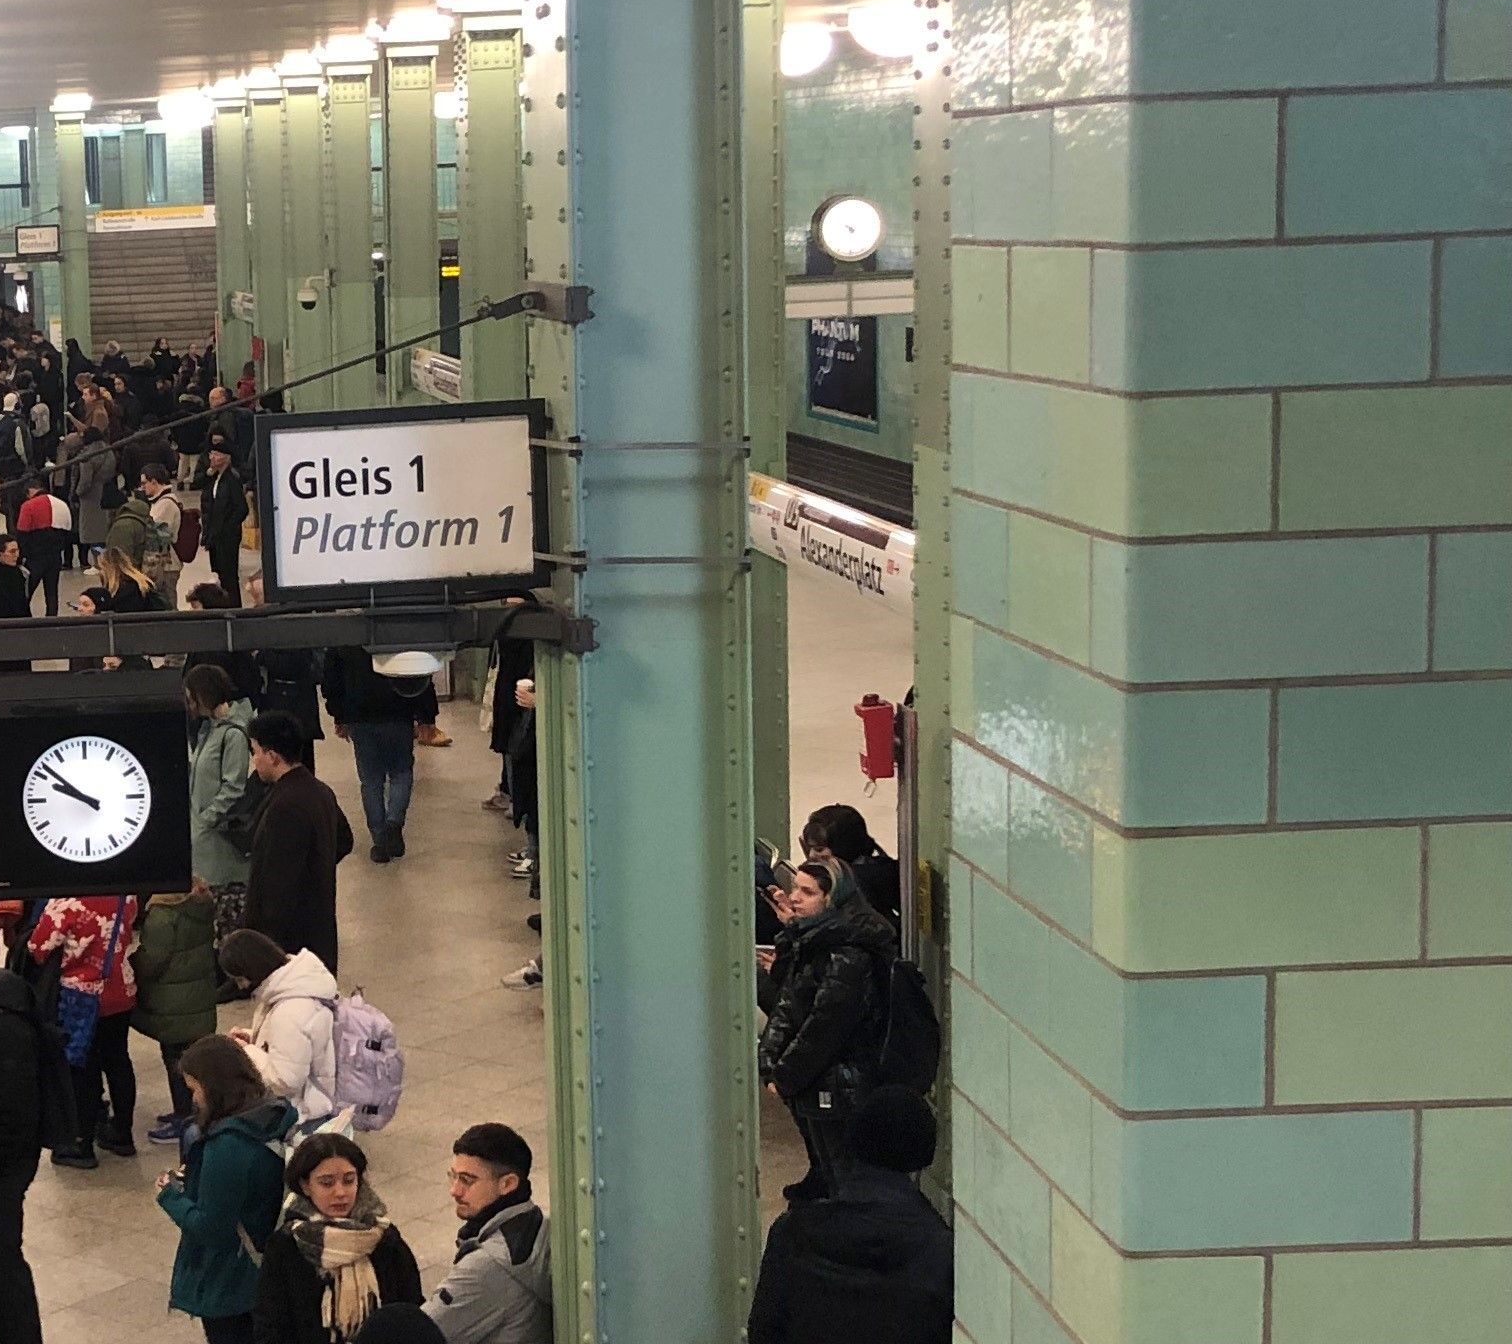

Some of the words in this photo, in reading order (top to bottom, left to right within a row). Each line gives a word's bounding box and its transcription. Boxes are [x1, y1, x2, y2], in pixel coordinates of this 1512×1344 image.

[288, 456, 392, 500] Gleis
[408, 454, 425, 493] 1
[292, 508, 479, 555] Platform
[497, 505, 515, 544] 1
[800, 524, 885, 596] Alexanderplatz
